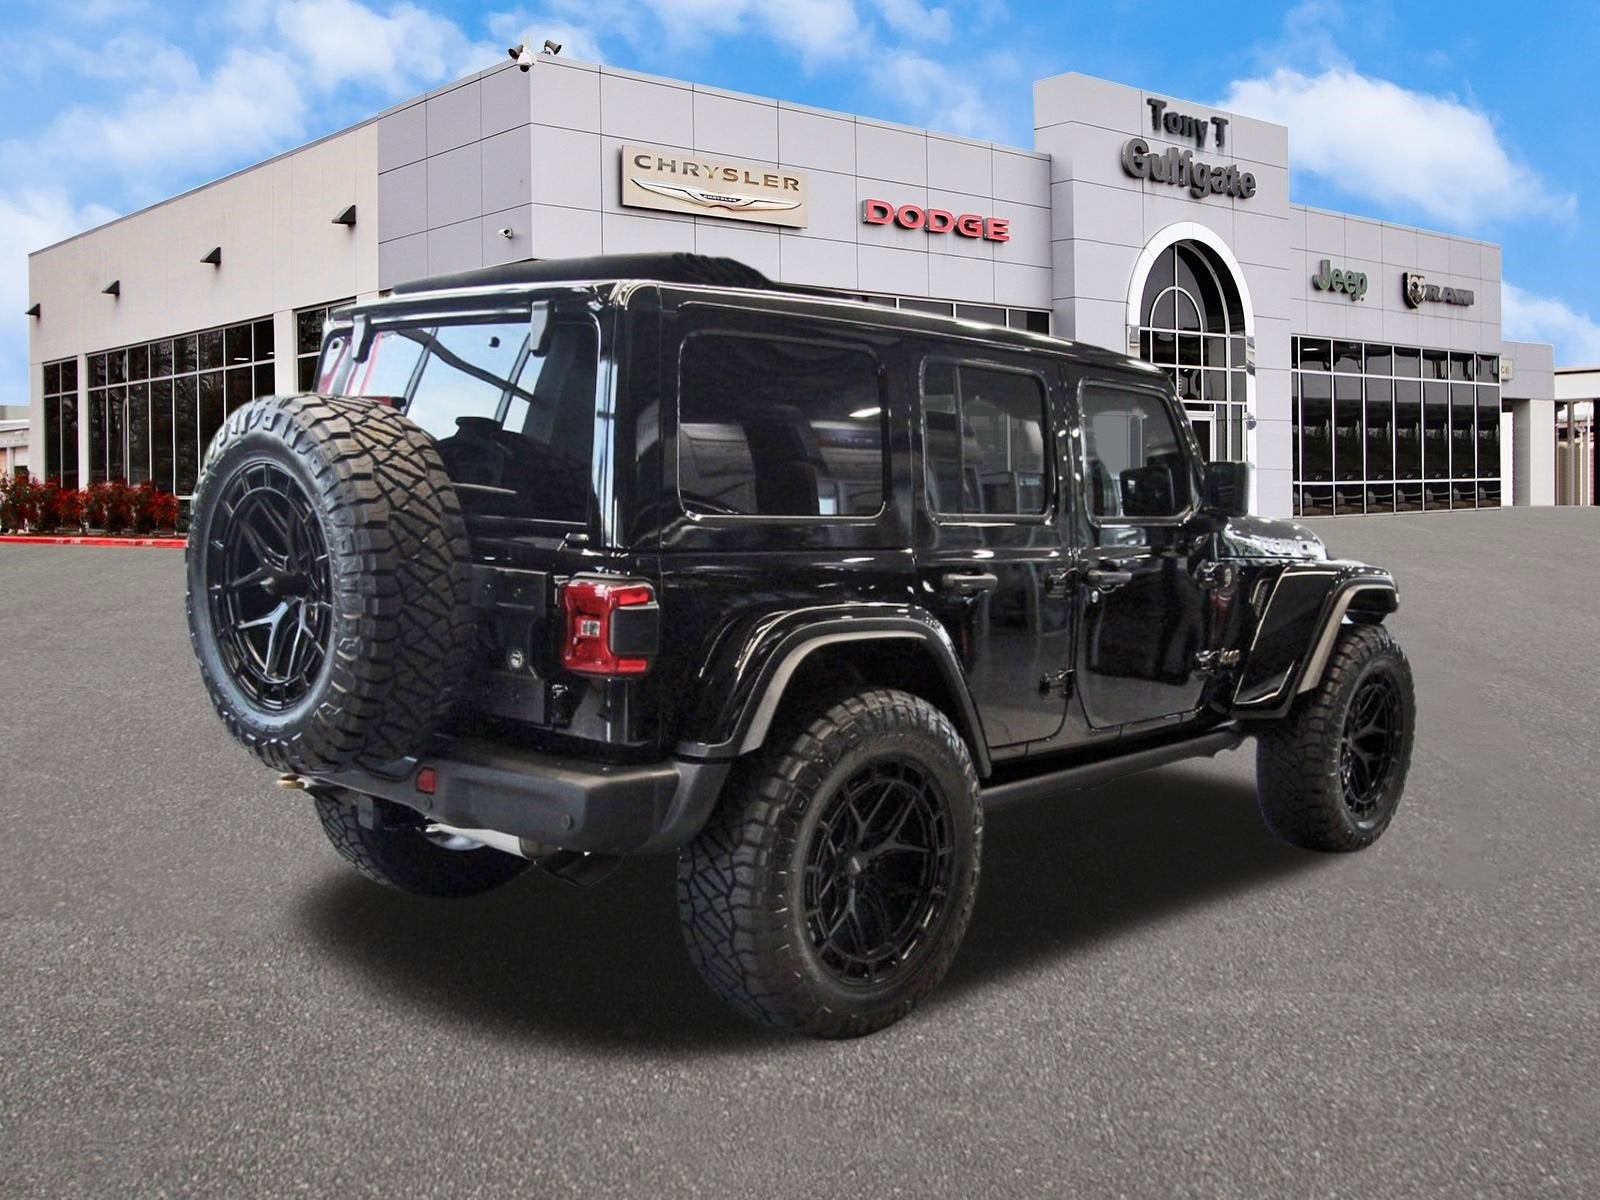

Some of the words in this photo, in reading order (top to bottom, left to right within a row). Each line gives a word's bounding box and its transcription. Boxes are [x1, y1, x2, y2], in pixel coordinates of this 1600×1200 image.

[1147, 98, 1208, 147] Tony
[1210, 116, 1229, 147] T
[634, 154, 800, 192] CHRYSLER
[1121, 137, 1257, 198] Gulfgate
[862, 198, 1010, 242] DODGE
[1312, 258, 1368, 301] Jeep
[1424, 283, 1475, 307] RAM
